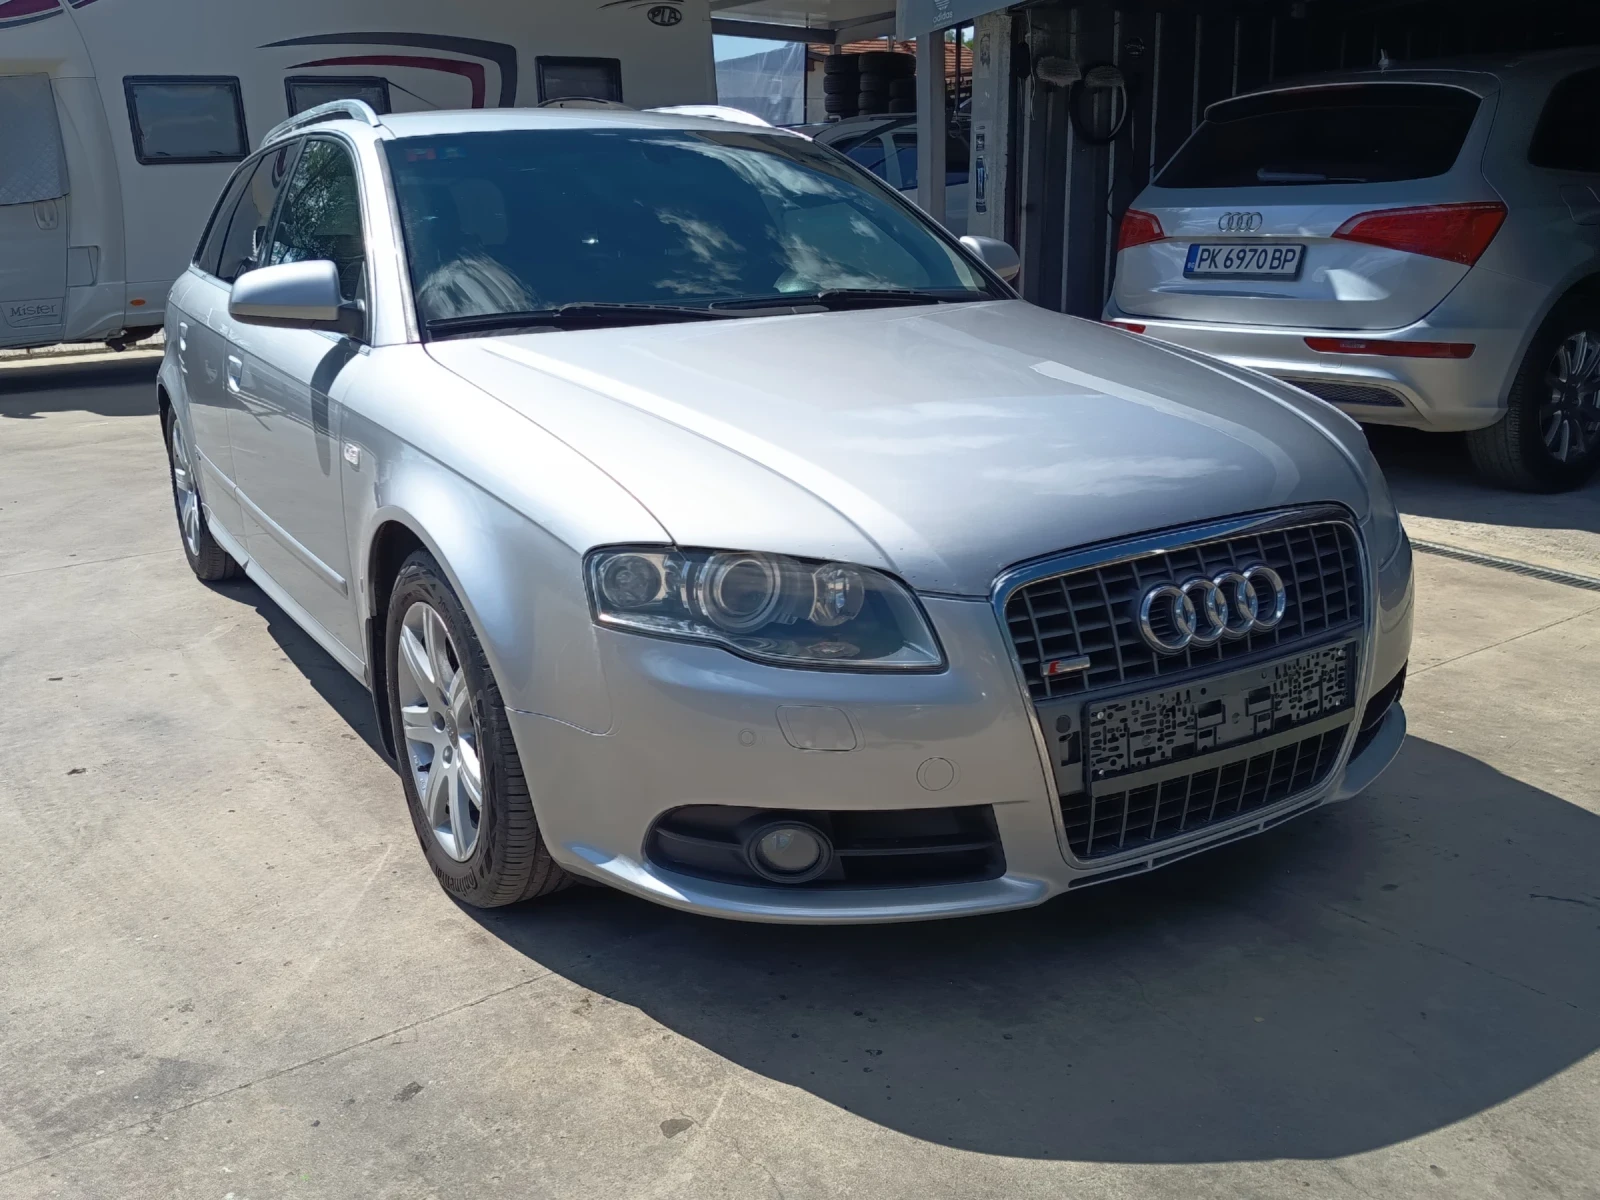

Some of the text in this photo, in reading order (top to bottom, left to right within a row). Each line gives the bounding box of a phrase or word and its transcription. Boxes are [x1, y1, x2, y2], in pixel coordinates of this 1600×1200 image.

[1197, 248, 1297, 270] PK 6970 BP
[10, 304, 57, 317] Mister
